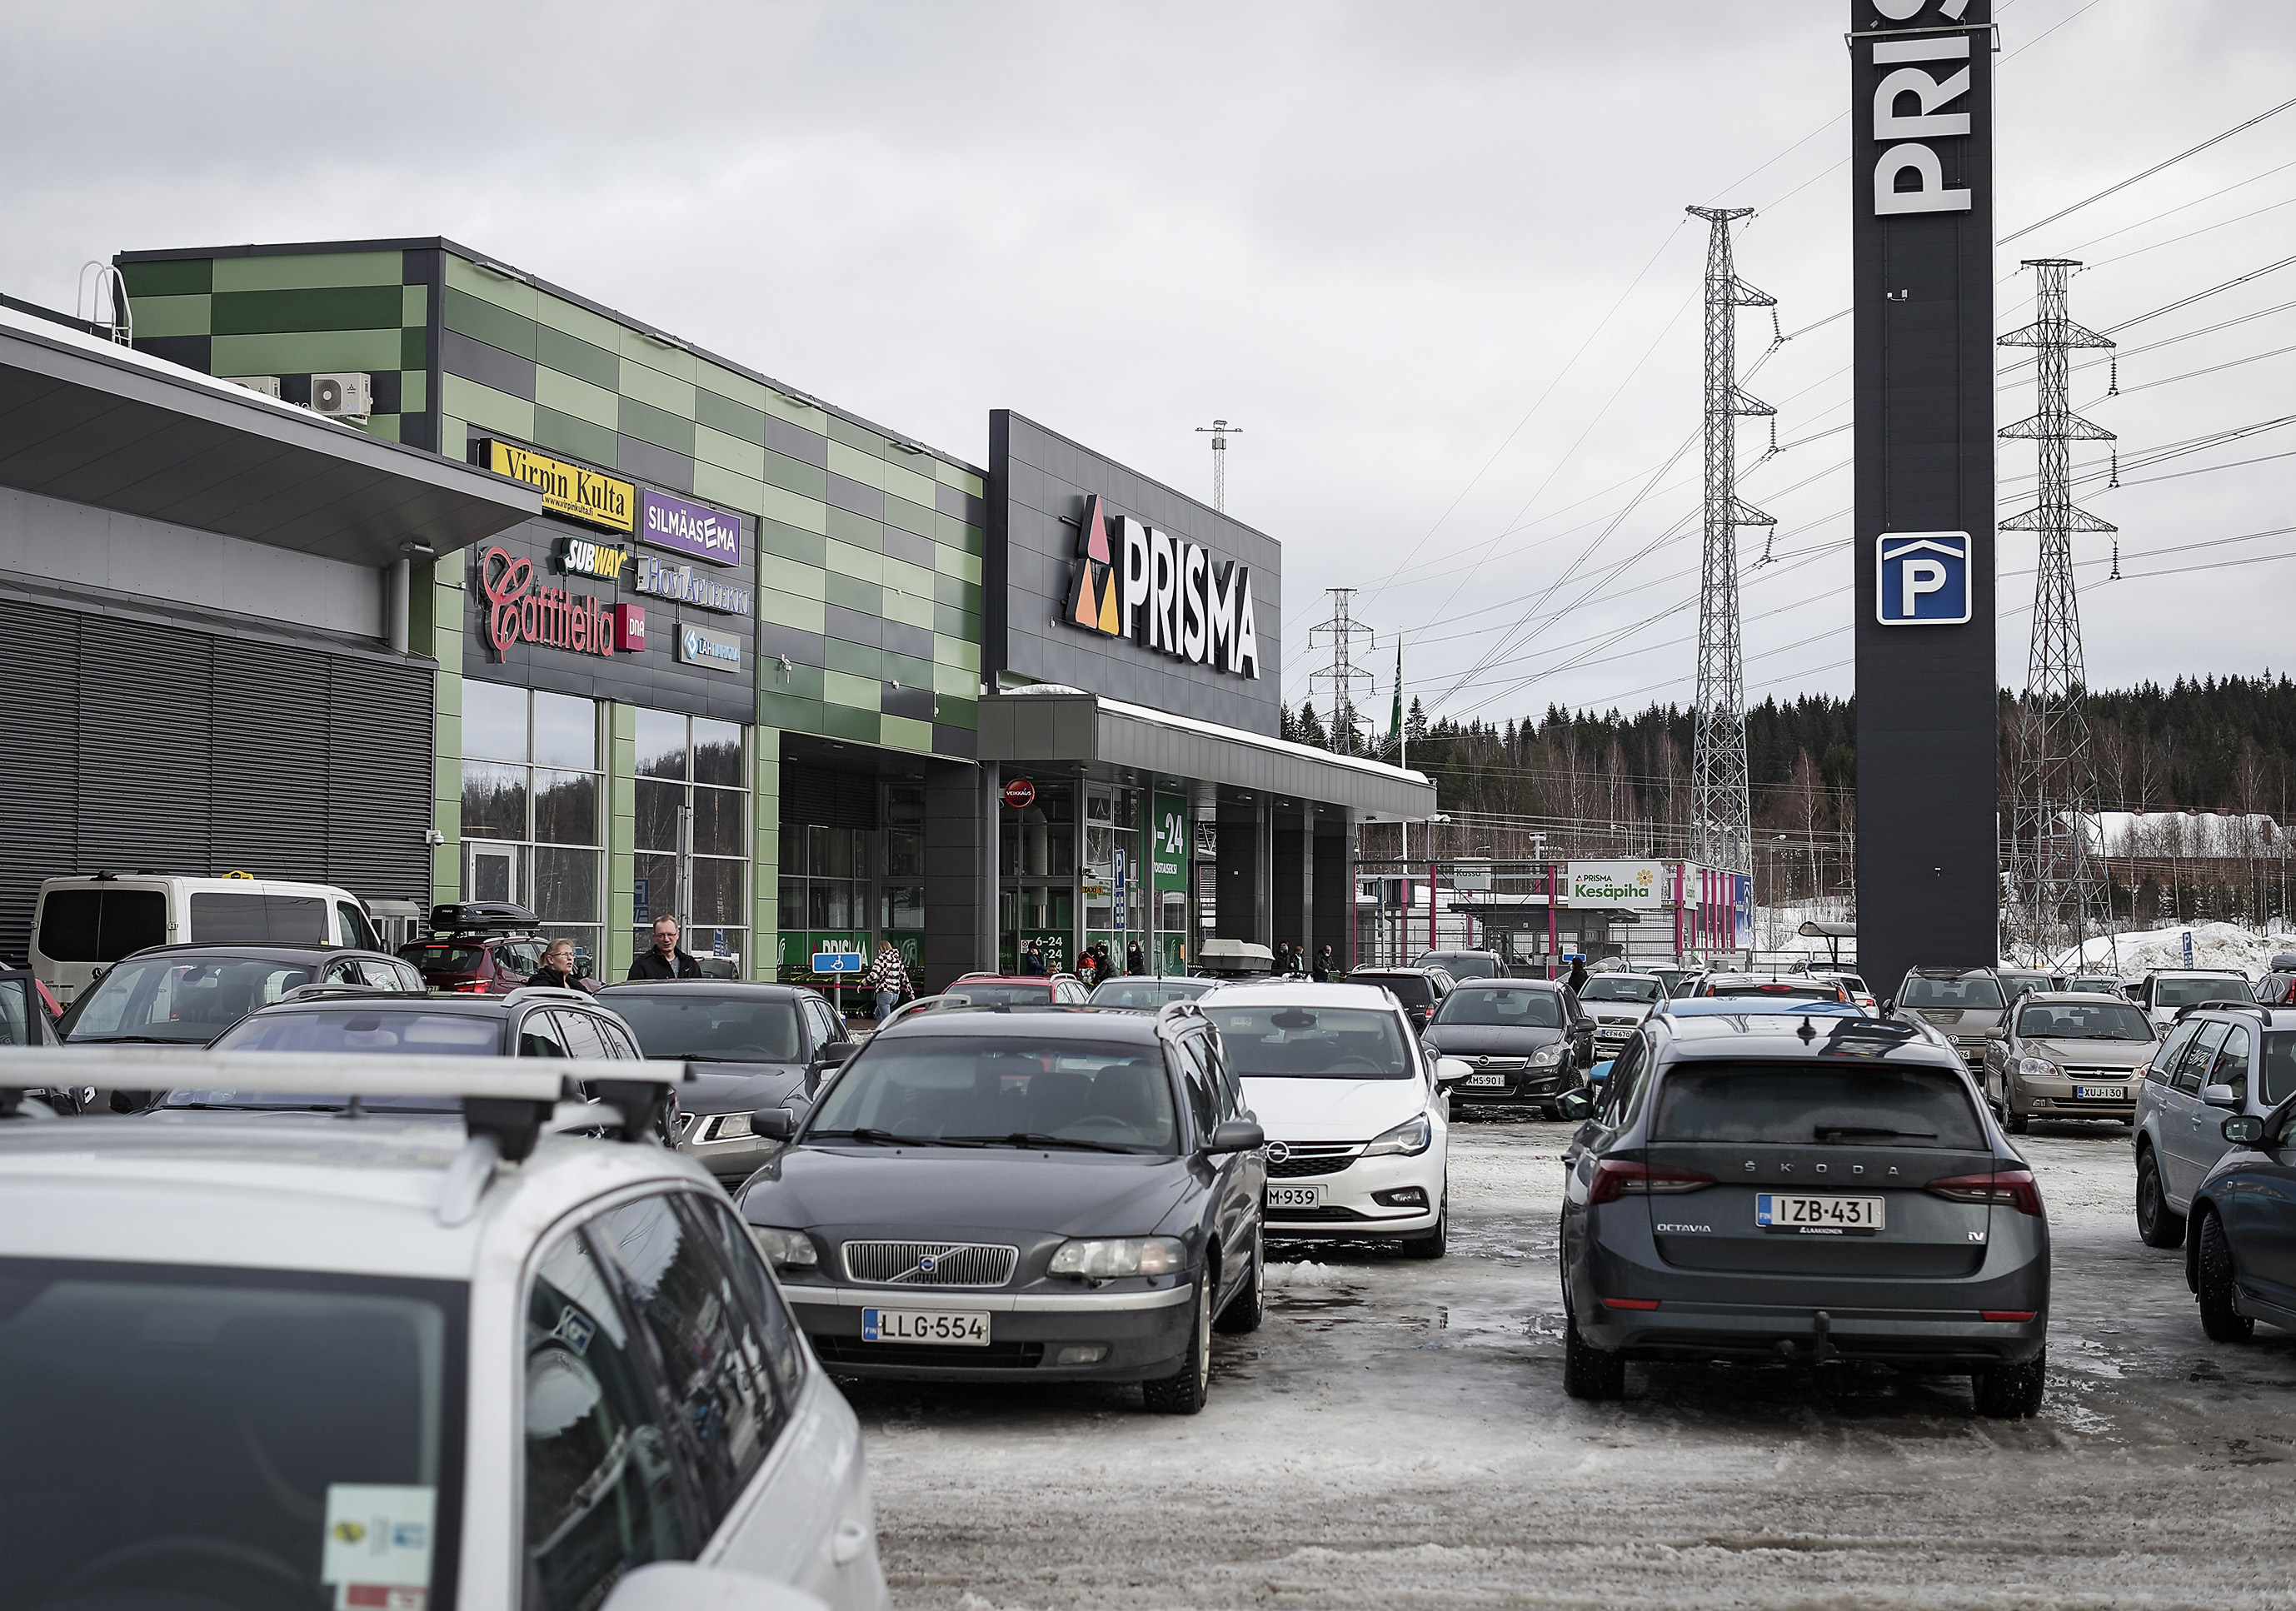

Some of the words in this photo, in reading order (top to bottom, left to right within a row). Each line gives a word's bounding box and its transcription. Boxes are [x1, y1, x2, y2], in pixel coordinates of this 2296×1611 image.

[1873, 0, 1971, 216] PRI
[505, 448, 568, 500] Virpin
[576, 470, 625, 516] Kulta
[544, 495, 593, 516] www.virpinkulta.fi
[648, 505, 736, 553] SILMÄASEMA
[565, 539, 627, 579] SUBWAY
[1123, 515, 1260, 680] PRISMA
[1902, 559, 1947, 616] P
[482, 546, 615, 664] Caffitella
[629, 618, 645, 638] DNA
[1006, 787, 1032, 796] VEIKKAUS
[1153, 812, 1184, 855] -24
[1116, 854, 1123, 886] P
[1153, 861, 1178, 875] OISTAISEKSI
[1575, 883, 1650, 901] Kesäpiha
[1035, 936, 1063, 947] 6-24
[2184, 934, 2190, 950] P
[1605, 1030, 1630, 1038] CFN-670
[1468, 1076, 1501, 1085] XMS-901
[2084, 1088, 2122, 1098] XUJ-130
[1744, 1160, 1899, 1175] ŠKODA
[1781, 1200, 1873, 1224] IZB-431
[1657, 1223, 1712, 1233] OCTAVIA
[865, 1326, 877, 1334] FIN
[881, 1314, 983, 1339] LLG-554
